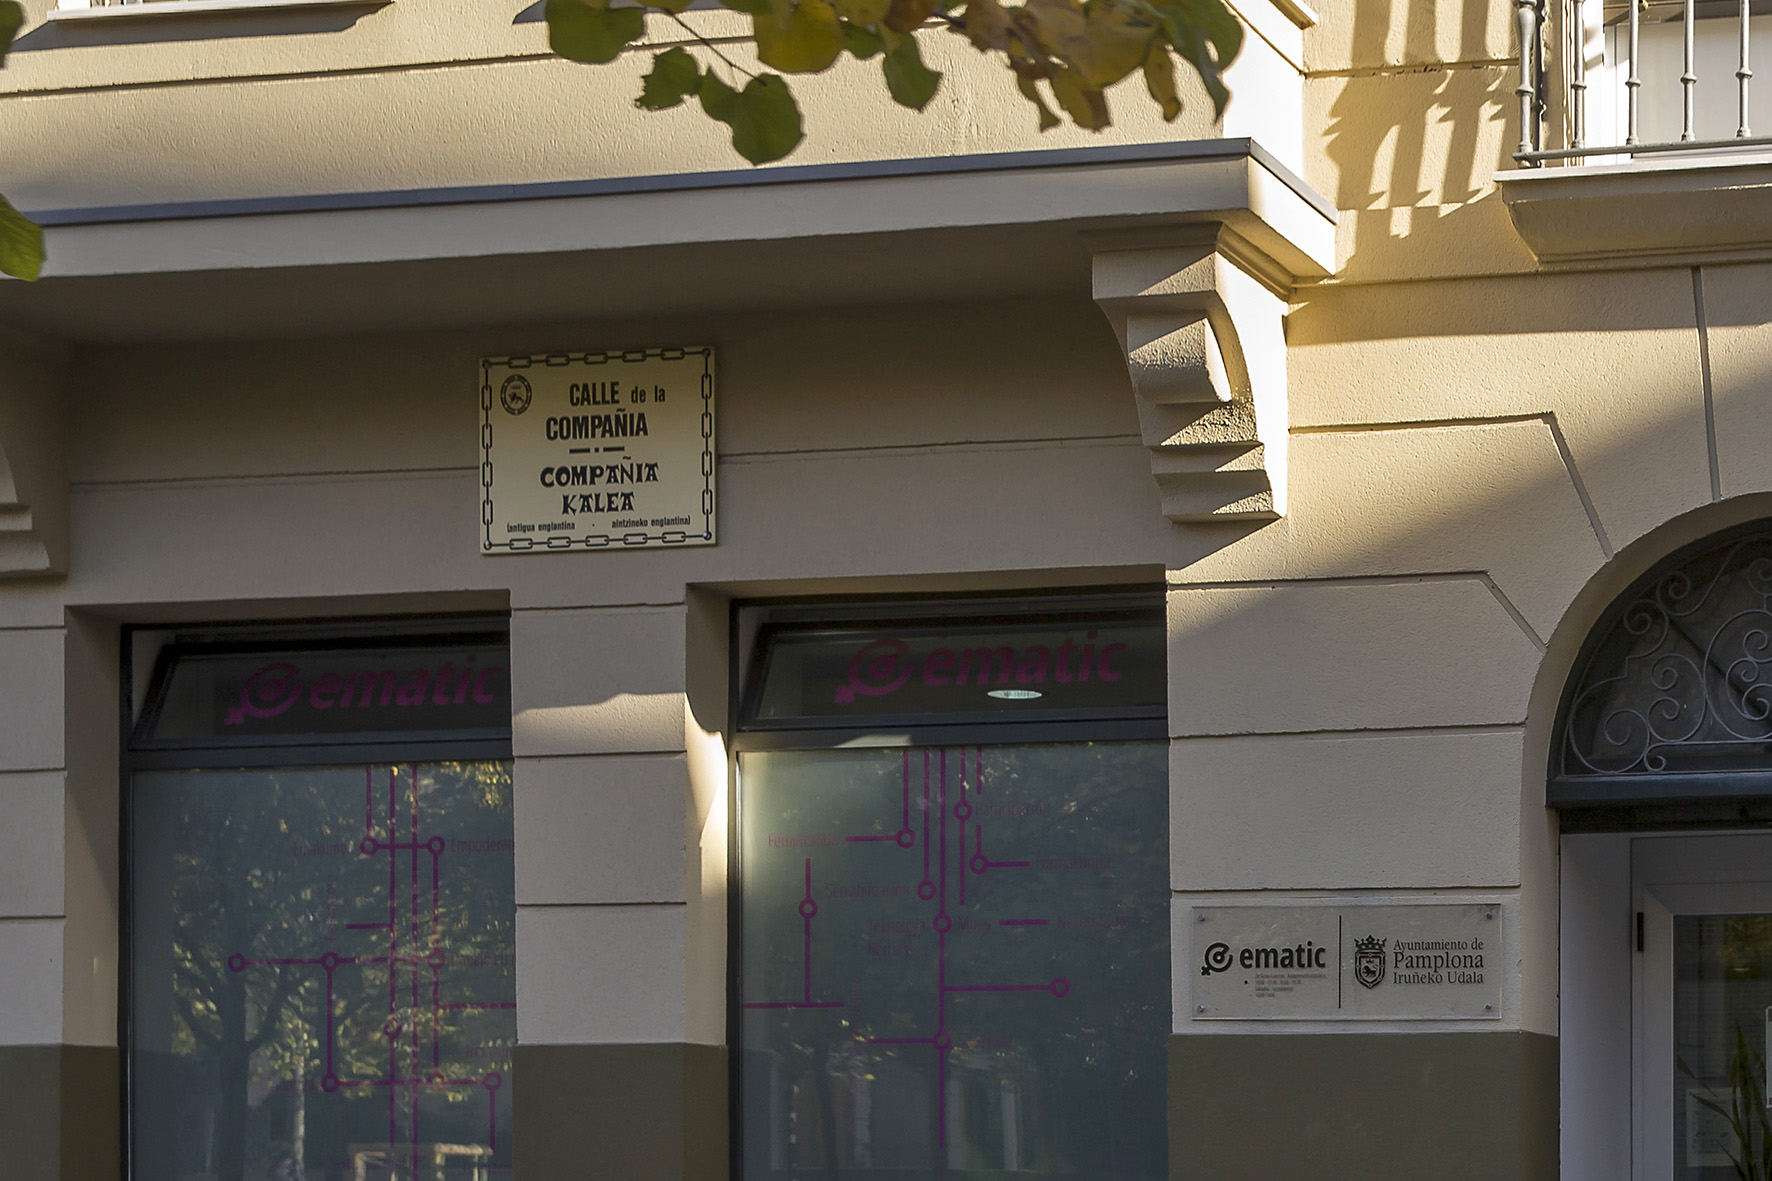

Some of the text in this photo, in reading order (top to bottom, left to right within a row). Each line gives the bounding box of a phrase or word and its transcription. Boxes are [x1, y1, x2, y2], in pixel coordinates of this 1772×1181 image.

[569, 381, 666, 407] CALLE de la
[546, 408, 648, 440] COMPAÑIA
[540, 456, 659, 488] COMPAÑIA
[562, 491, 634, 516] KALEA
[1239, 941, 1326, 969] ematic
[1393, 938, 1484, 952] Ayuntamiento de
[1393, 951, 1484, 972] Pamplona
[1393, 971, 1484, 985] Iruñeko Udala
